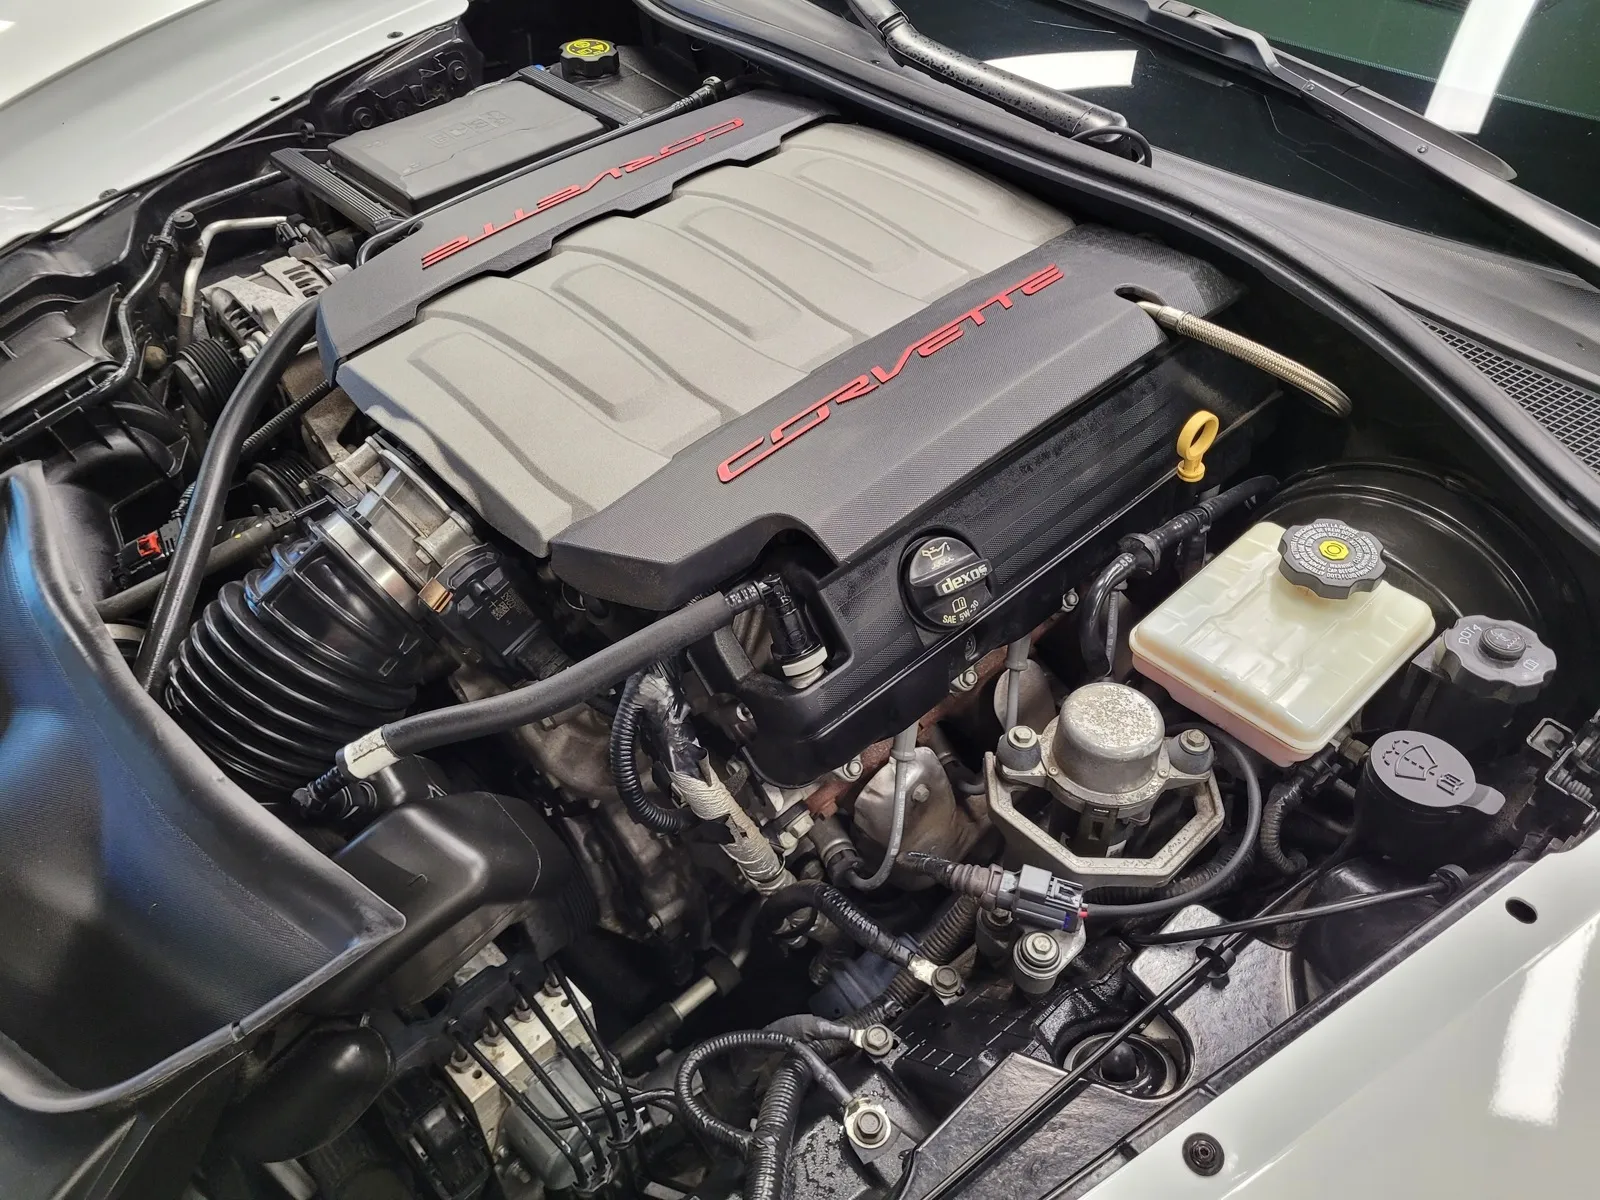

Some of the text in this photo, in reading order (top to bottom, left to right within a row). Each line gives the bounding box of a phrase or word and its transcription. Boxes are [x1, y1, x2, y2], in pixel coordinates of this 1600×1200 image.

[421, 117, 744, 270] CORVETTE
[716, 262, 1064, 484] CORVETTE
[941, 564, 988, 594] dexos
[942, 600, 979, 624] SAE 5W-30
